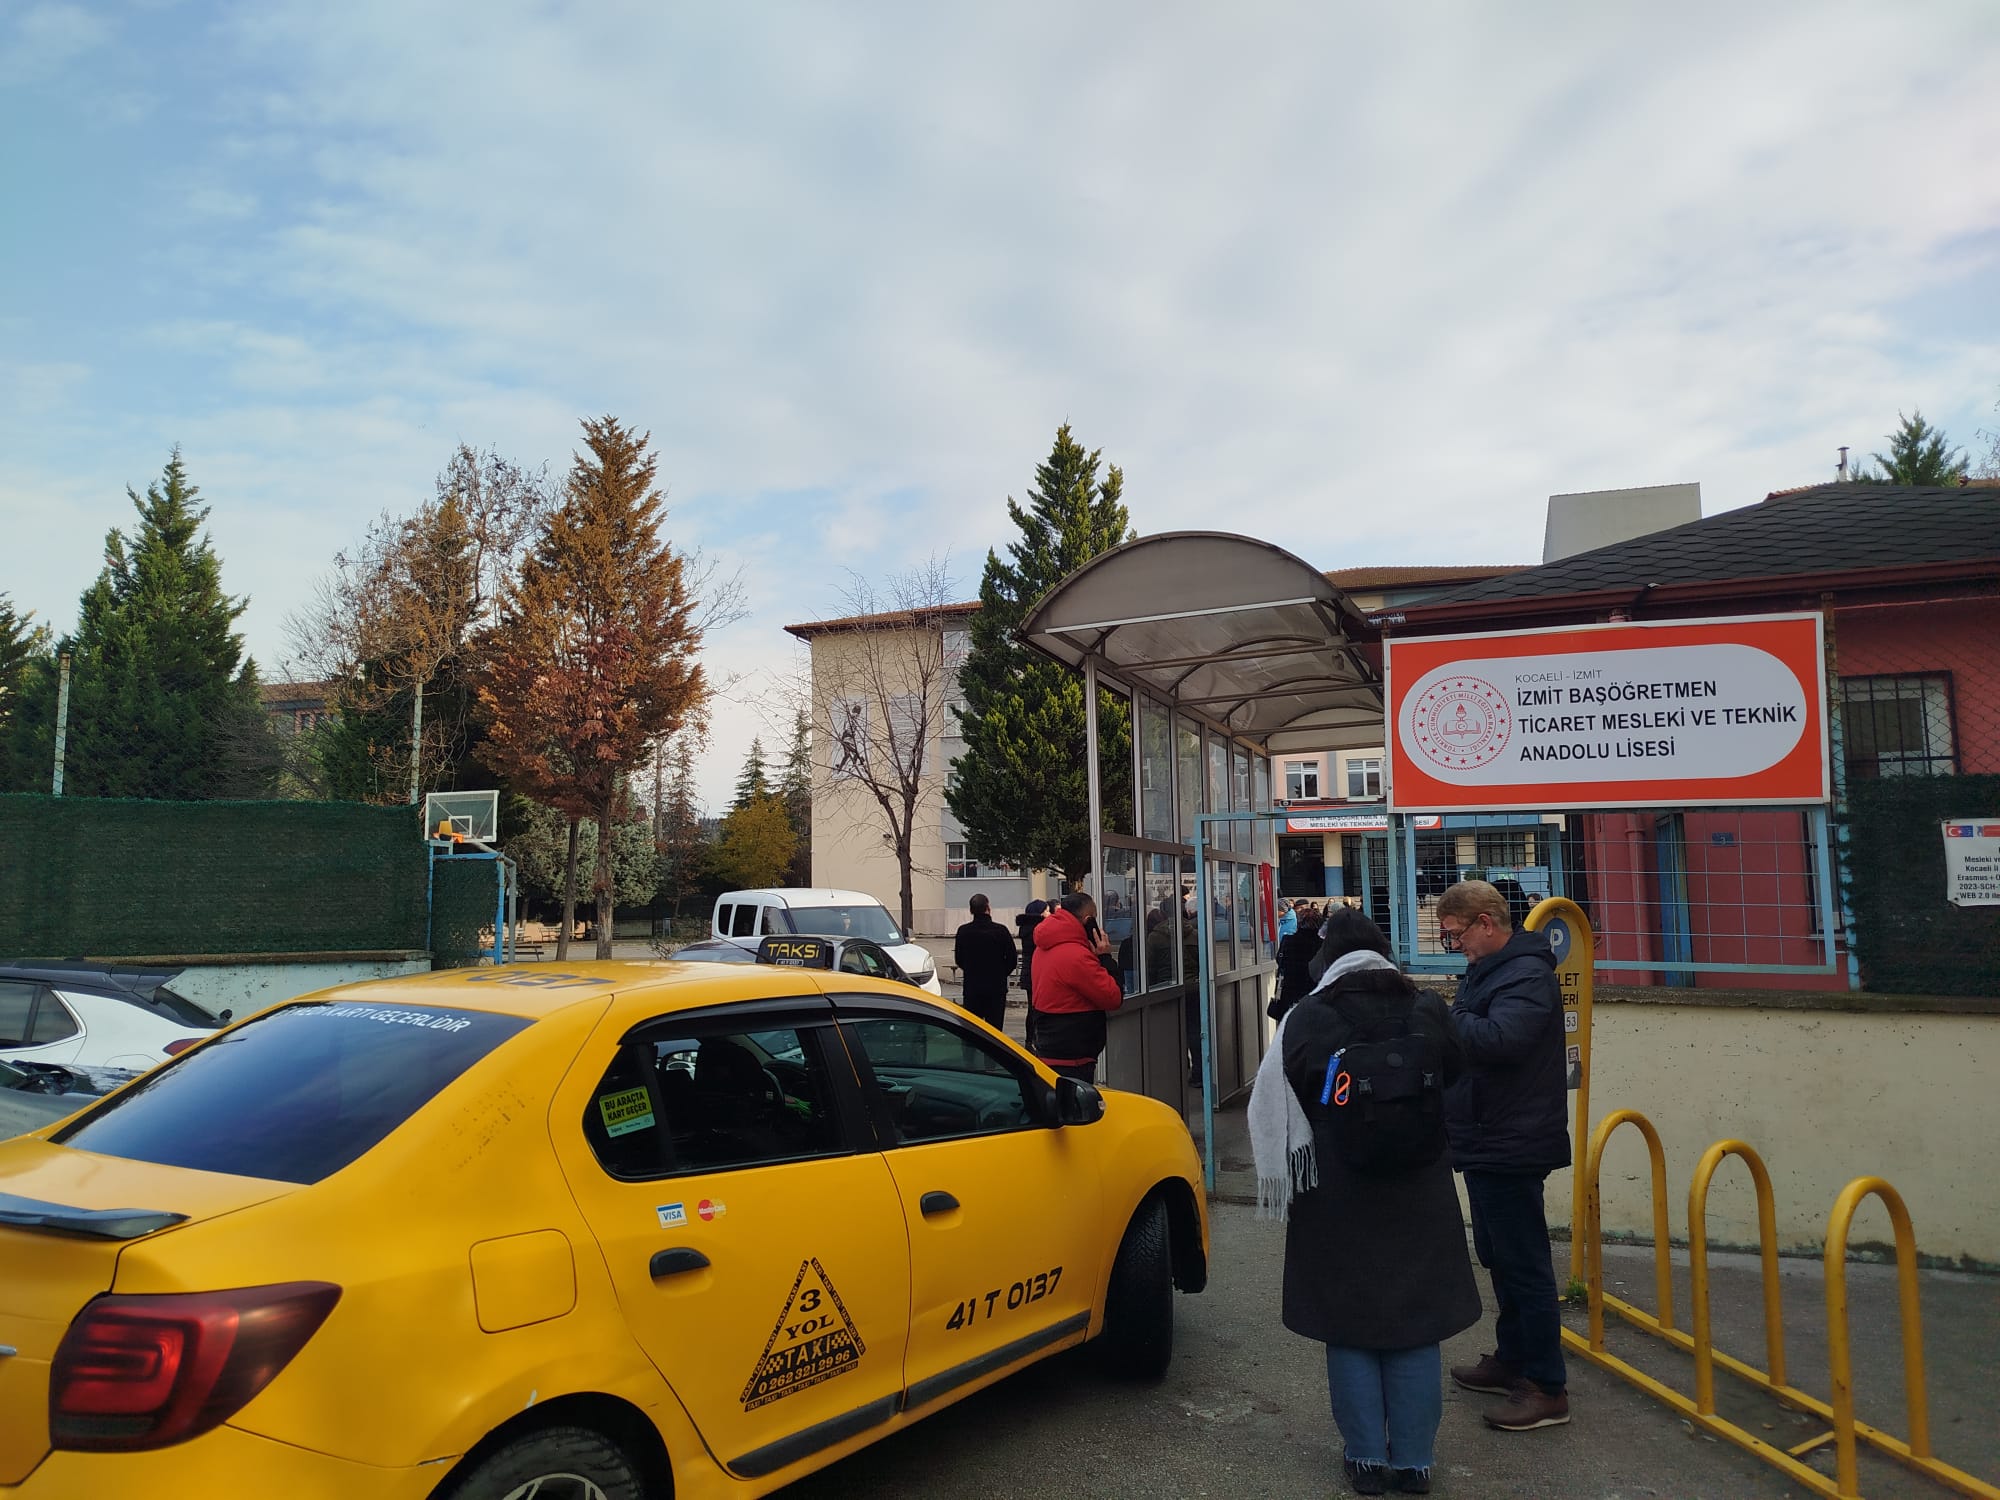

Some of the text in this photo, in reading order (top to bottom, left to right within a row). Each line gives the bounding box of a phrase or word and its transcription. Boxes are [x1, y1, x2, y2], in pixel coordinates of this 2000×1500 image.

[1515, 671, 1563, 684] KOCAELİ
[1573, 668, 1603, 681] İZMİT
[1517, 680, 1717, 706] İZMİT BAŞÖĞRETMEN
[1518, 702, 1797, 734] TİCARET MESLEKİ VE TEKNİK
[1520, 736, 1675, 762] ANADOLU LİSESİ
[1562, 991, 1579, 1006] ERİ
[369, 1010, 472, 1033] GEÇERLİDİR
[1566, 1016, 1577, 1027] 53
[604, 1091, 645, 1111] BU ARAÇTA
[608, 1102, 647, 1122] KART GEÇER
[663, 1210, 682, 1221] VISA
[799, 1288, 822, 1313] 3
[946, 1266, 1063, 1330] 41 T 0137
[784, 1314, 835, 1341] YOL
[784, 1334, 832, 1369] TAXI
[758, 1350, 850, 1394] 0 262 321 29 96
